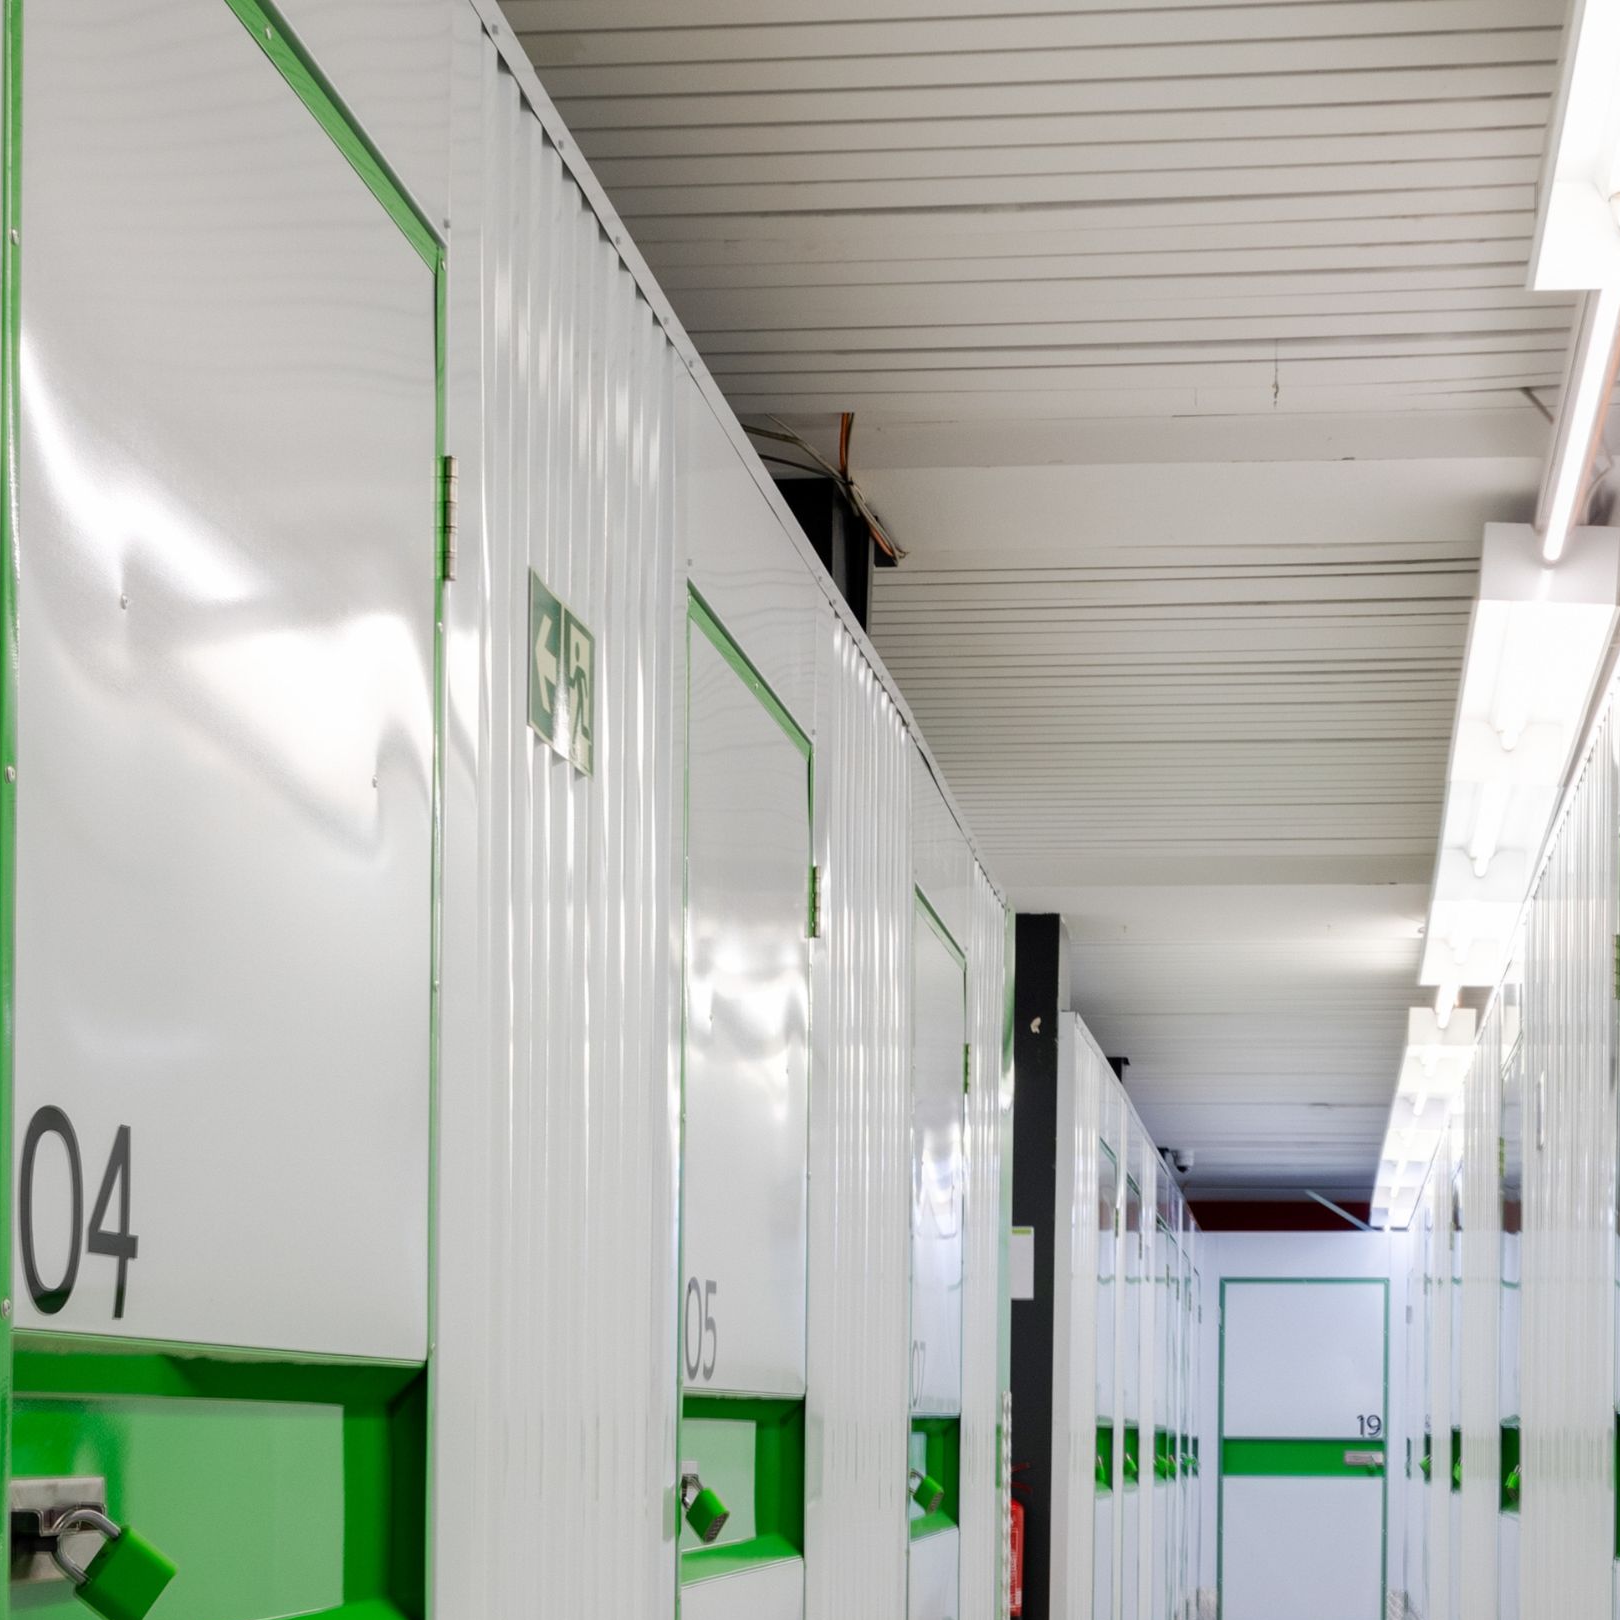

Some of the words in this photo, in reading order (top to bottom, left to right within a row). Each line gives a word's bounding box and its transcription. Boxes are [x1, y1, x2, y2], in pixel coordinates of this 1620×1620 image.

[19, 1104, 139, 1320] 04
[684, 1276, 717, 1381] 05
[911, 1340, 926, 1408] 07
[1357, 1414, 1382, 1436] 19
